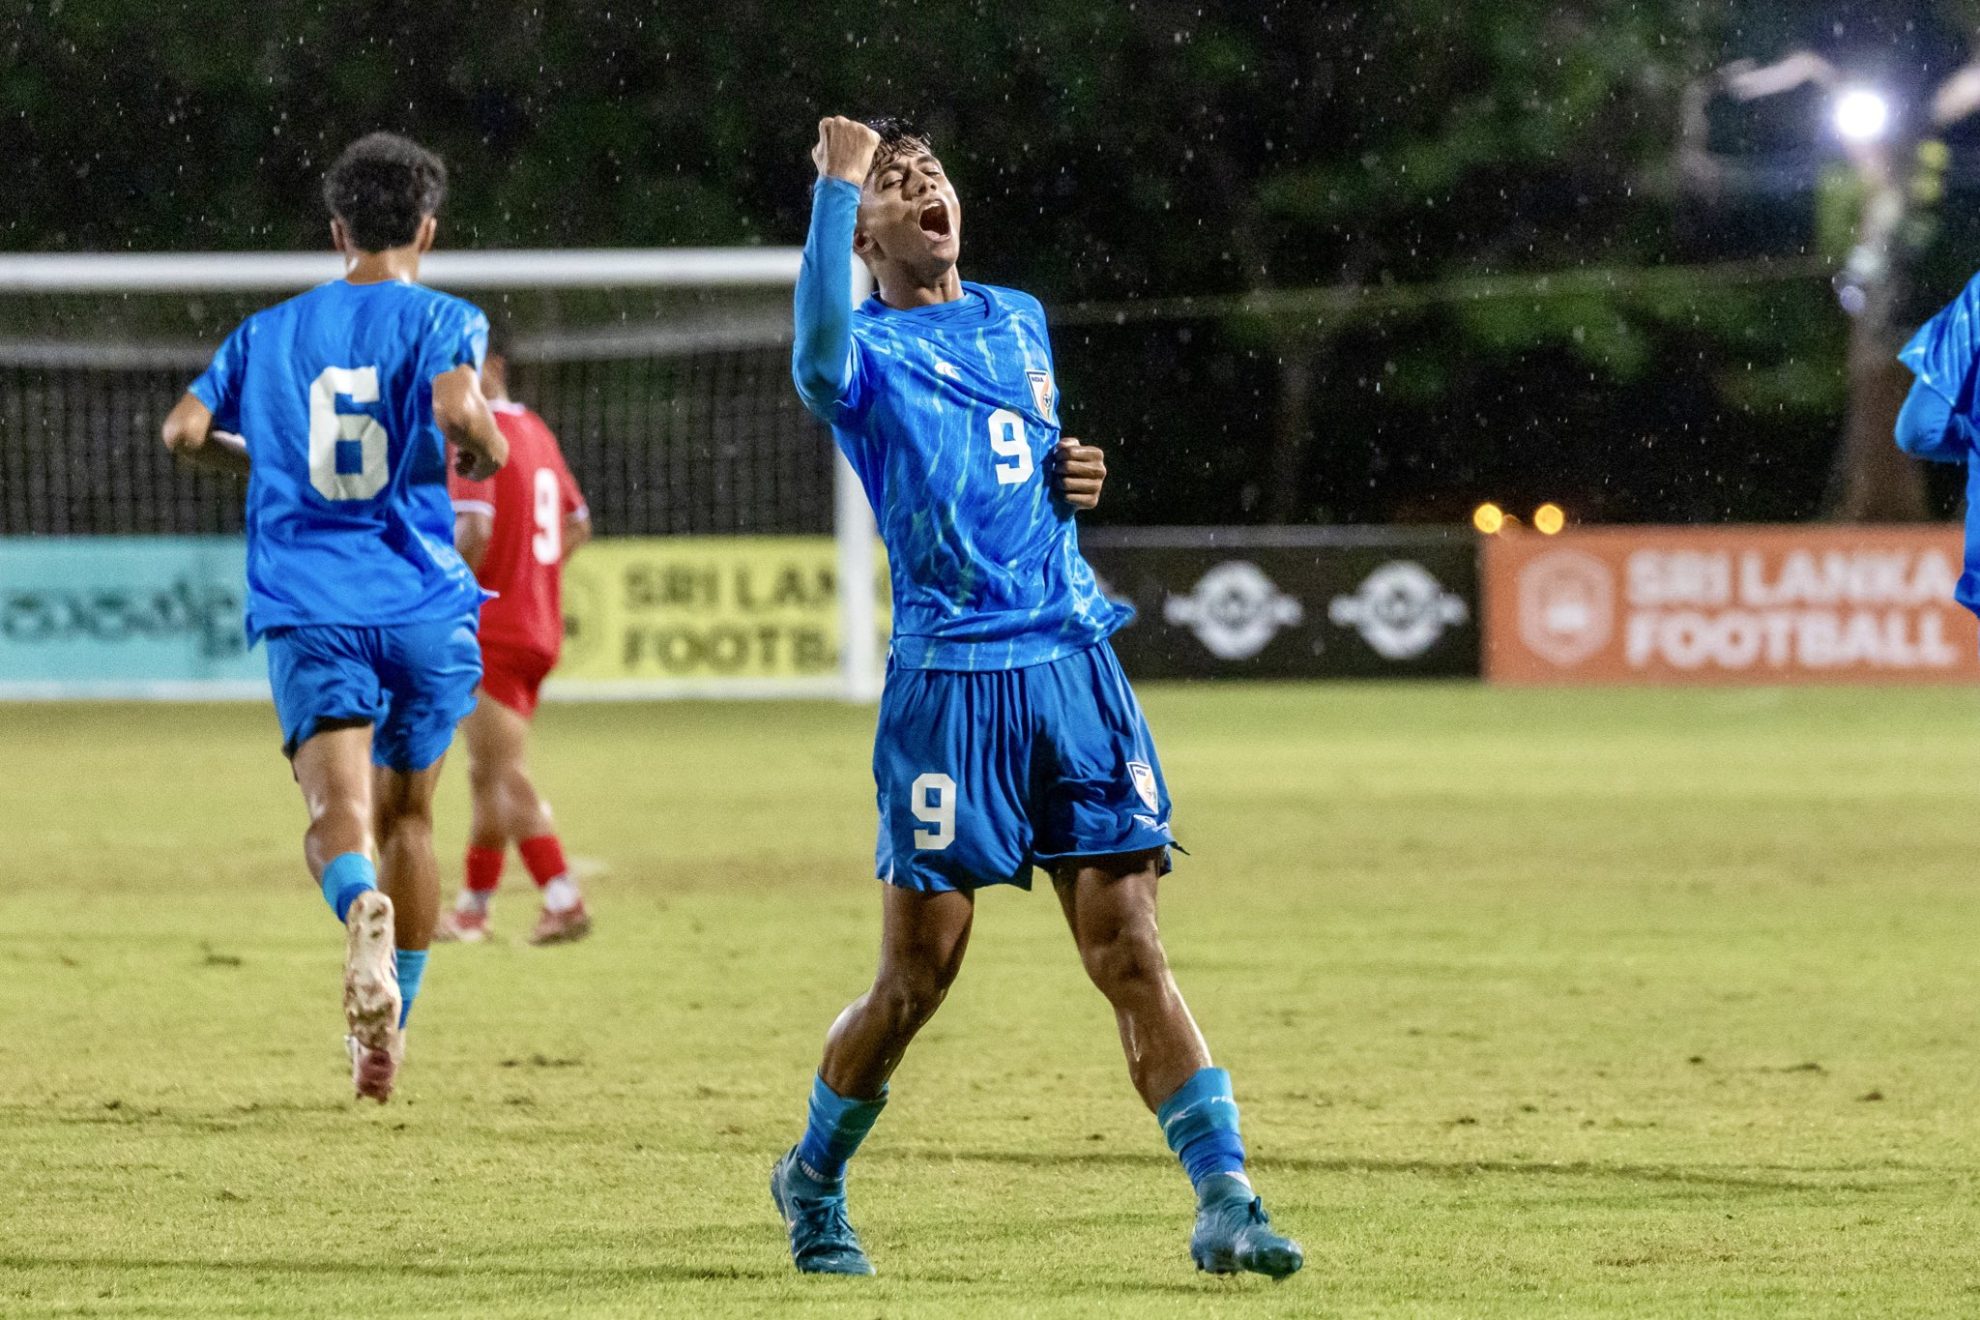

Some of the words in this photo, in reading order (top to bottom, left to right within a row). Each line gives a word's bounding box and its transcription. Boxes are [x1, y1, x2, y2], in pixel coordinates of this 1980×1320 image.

[309, 366, 389, 501] 6
[988, 408, 1034, 485] 9
[532, 467, 562, 565] 9
[624, 562, 719, 611] SRI
[1625, 550, 1730, 605] SRI
[1740, 549, 1956, 605] LANKA
[622, 624, 838, 672] FOOTB
[1625, 612, 1957, 668] FOOTBALL
[911, 773, 957, 850] 9
